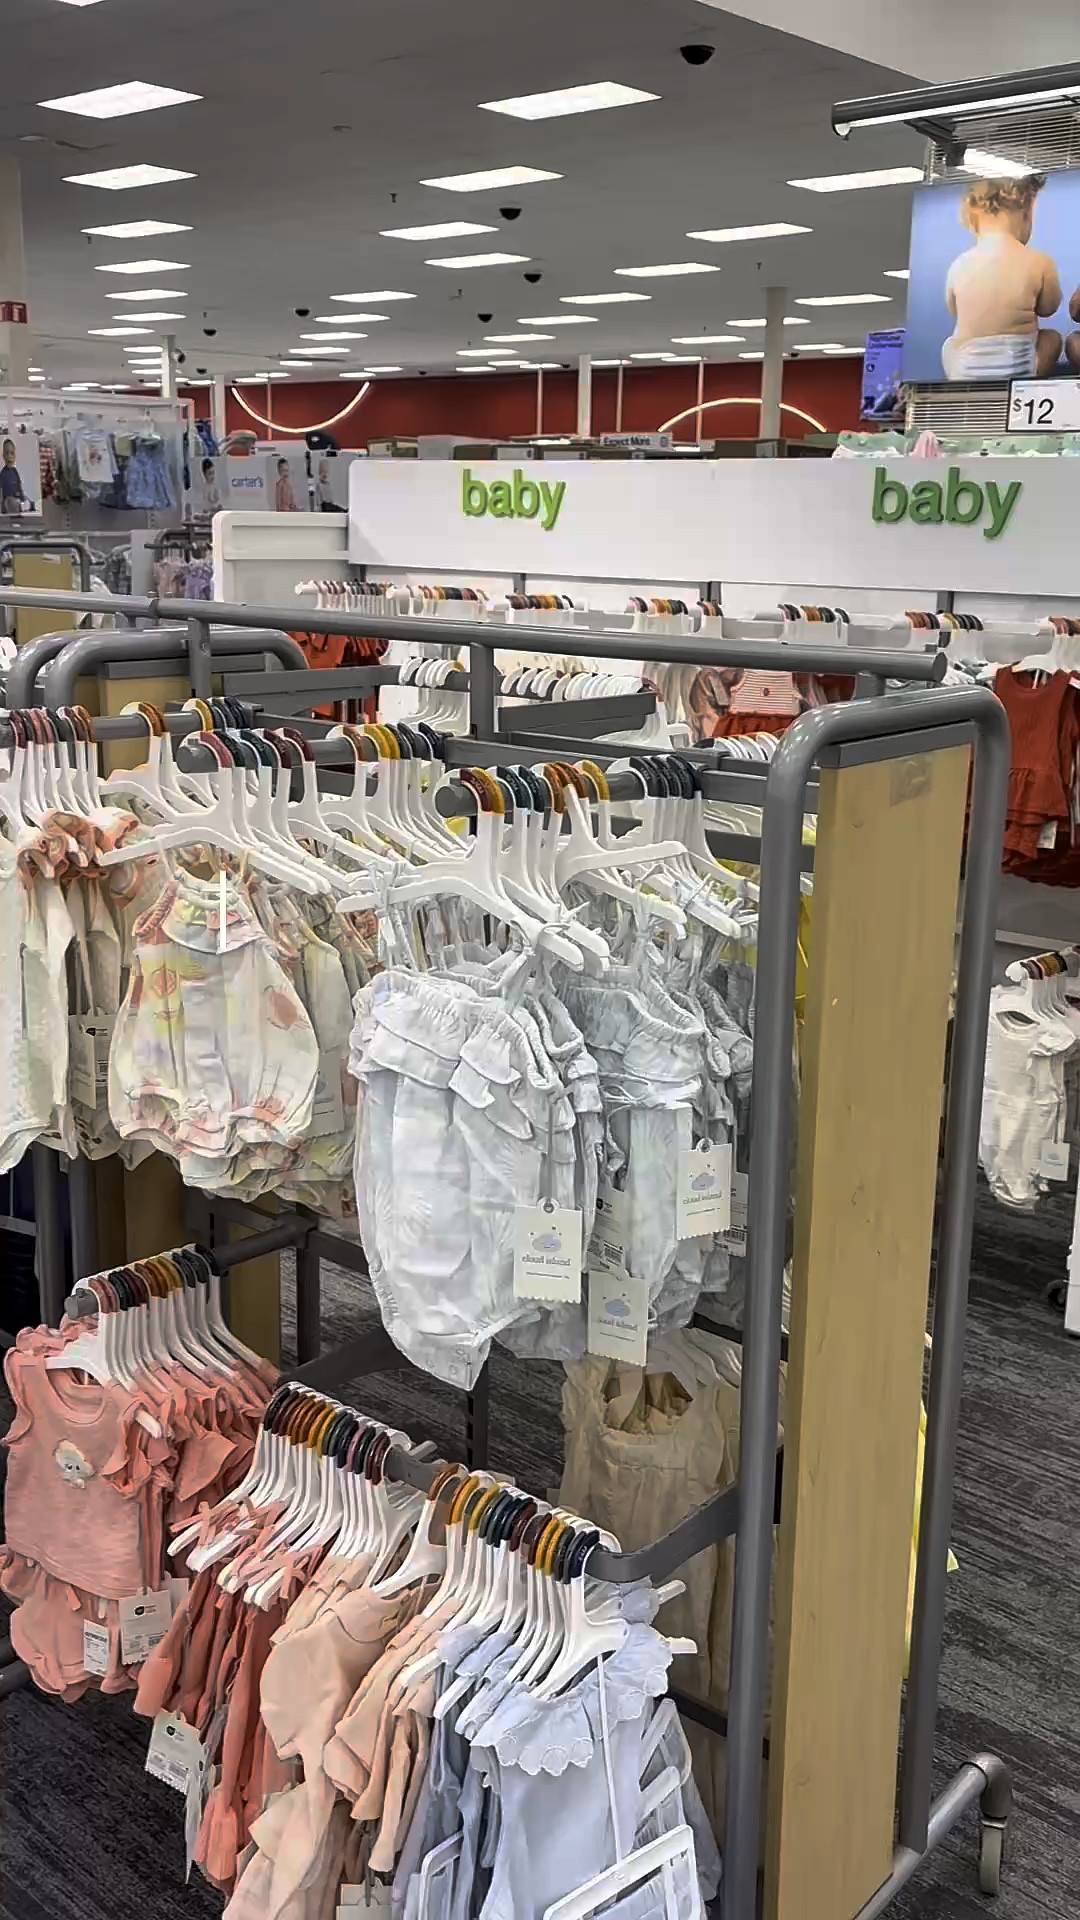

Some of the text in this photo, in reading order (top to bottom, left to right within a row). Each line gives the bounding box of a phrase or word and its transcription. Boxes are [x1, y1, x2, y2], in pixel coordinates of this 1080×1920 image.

[1013, 398, 1054, 425] $12
[463, 468, 566, 531] baby
[872, 466, 1023, 540] baby
